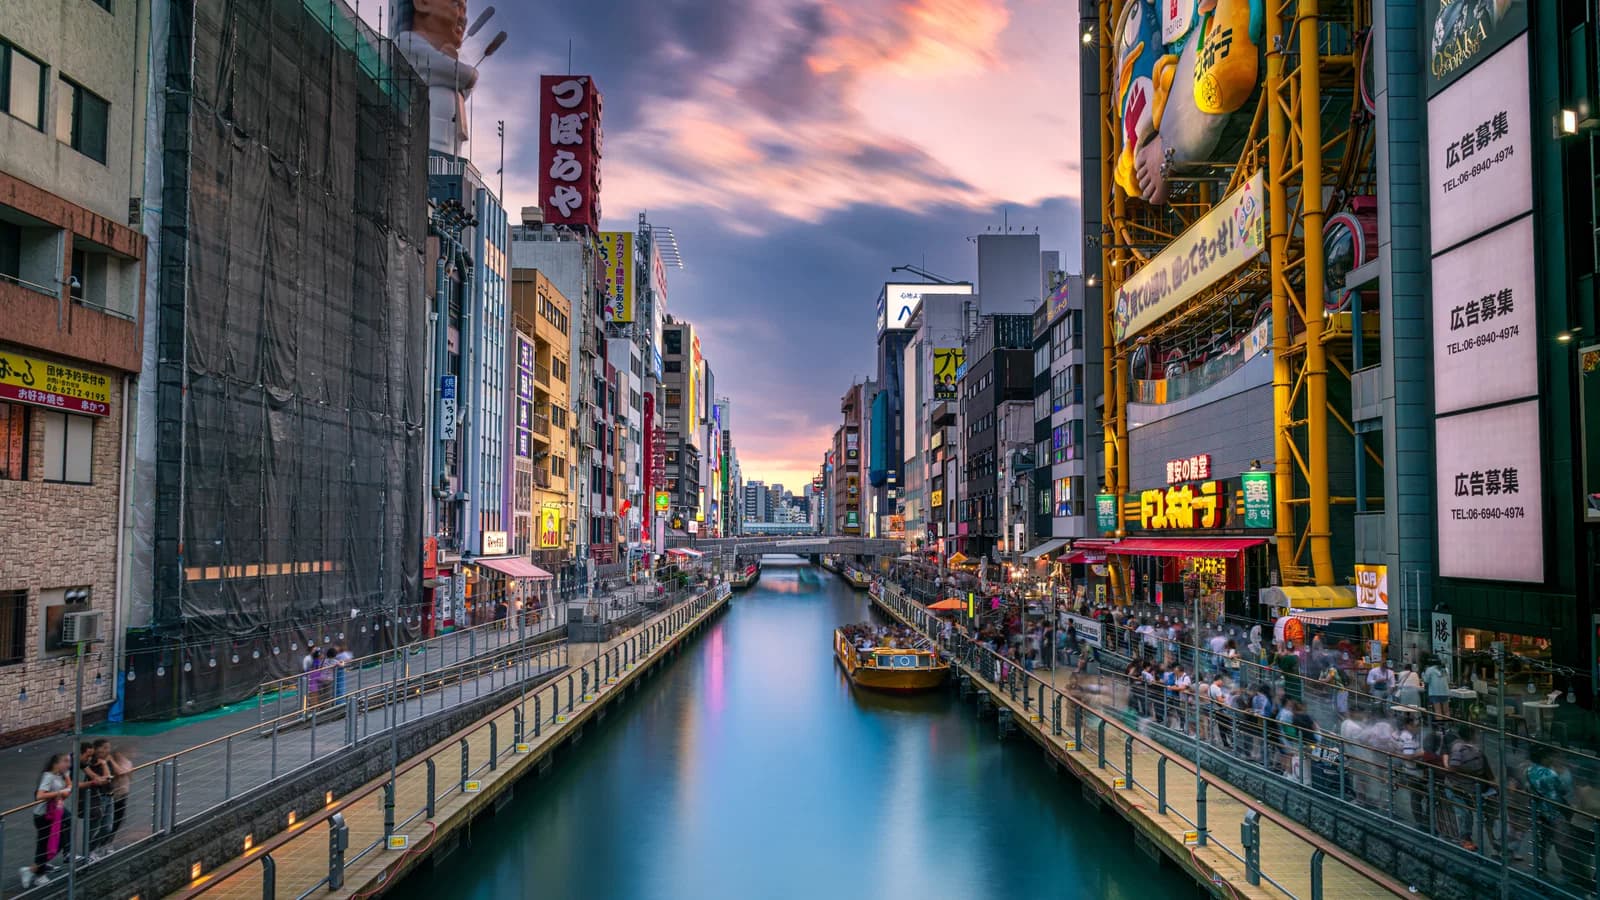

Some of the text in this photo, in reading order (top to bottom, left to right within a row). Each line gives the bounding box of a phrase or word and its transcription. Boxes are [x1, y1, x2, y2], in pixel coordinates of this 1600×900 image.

[550, 77, 589, 218] づぼらや
[1446, 111, 1508, 169] 広告募集
[1443, 145, 1514, 193] TEL:06-6940-4974
[1451, 288, 1513, 331] 広告募集
[1447, 325, 1519, 355] TEL:06-6940-4974
[18, 388, 105, 413] お好み焼き 串かつ
[1246, 480, 1269, 502] 薬
[1455, 467, 1518, 496] 広告募集
[1451, 507, 1524, 520] TEL:06-6940-4974
